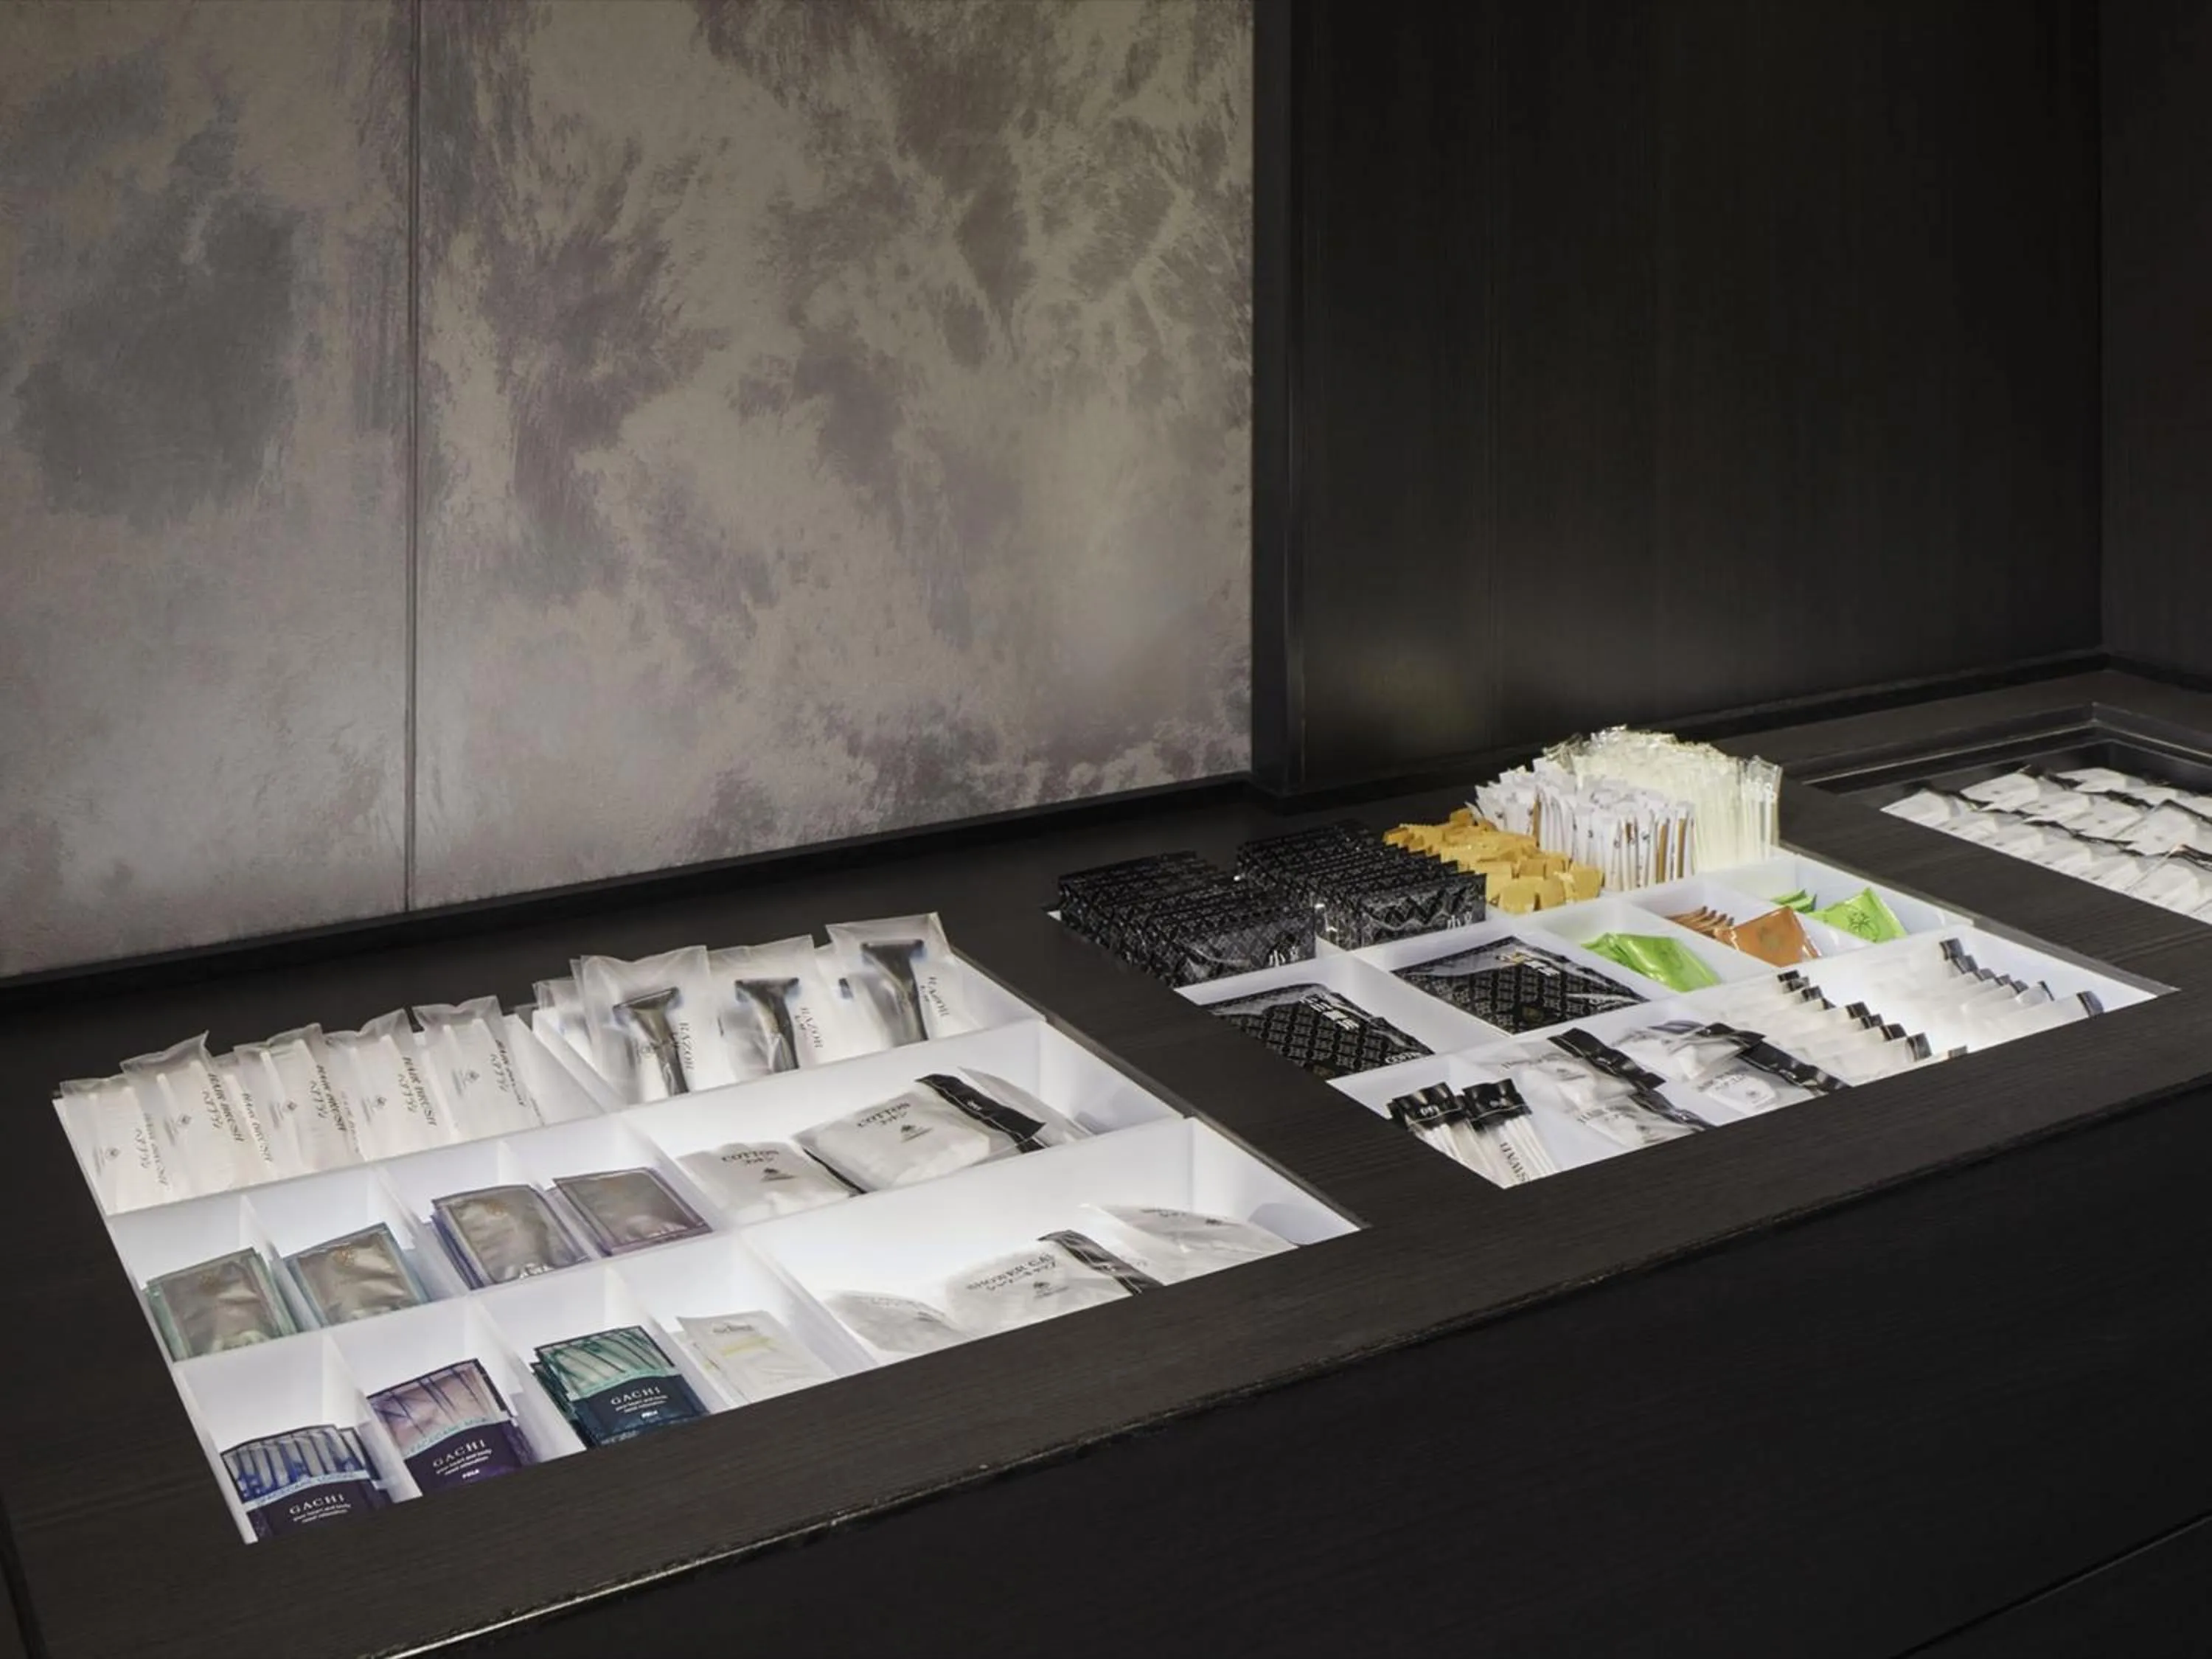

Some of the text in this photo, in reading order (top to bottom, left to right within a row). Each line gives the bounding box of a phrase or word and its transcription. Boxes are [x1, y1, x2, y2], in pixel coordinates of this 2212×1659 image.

[678, 1021, 695, 1070] RAZOR
[800, 1006, 823, 1048] RAZOR
[220, 1102, 246, 1142] BRUSH
[414, 1086, 437, 1127] BRUSH
[856, 1102, 911, 1128] COTTON
[720, 1150, 779, 1163] COTTON
